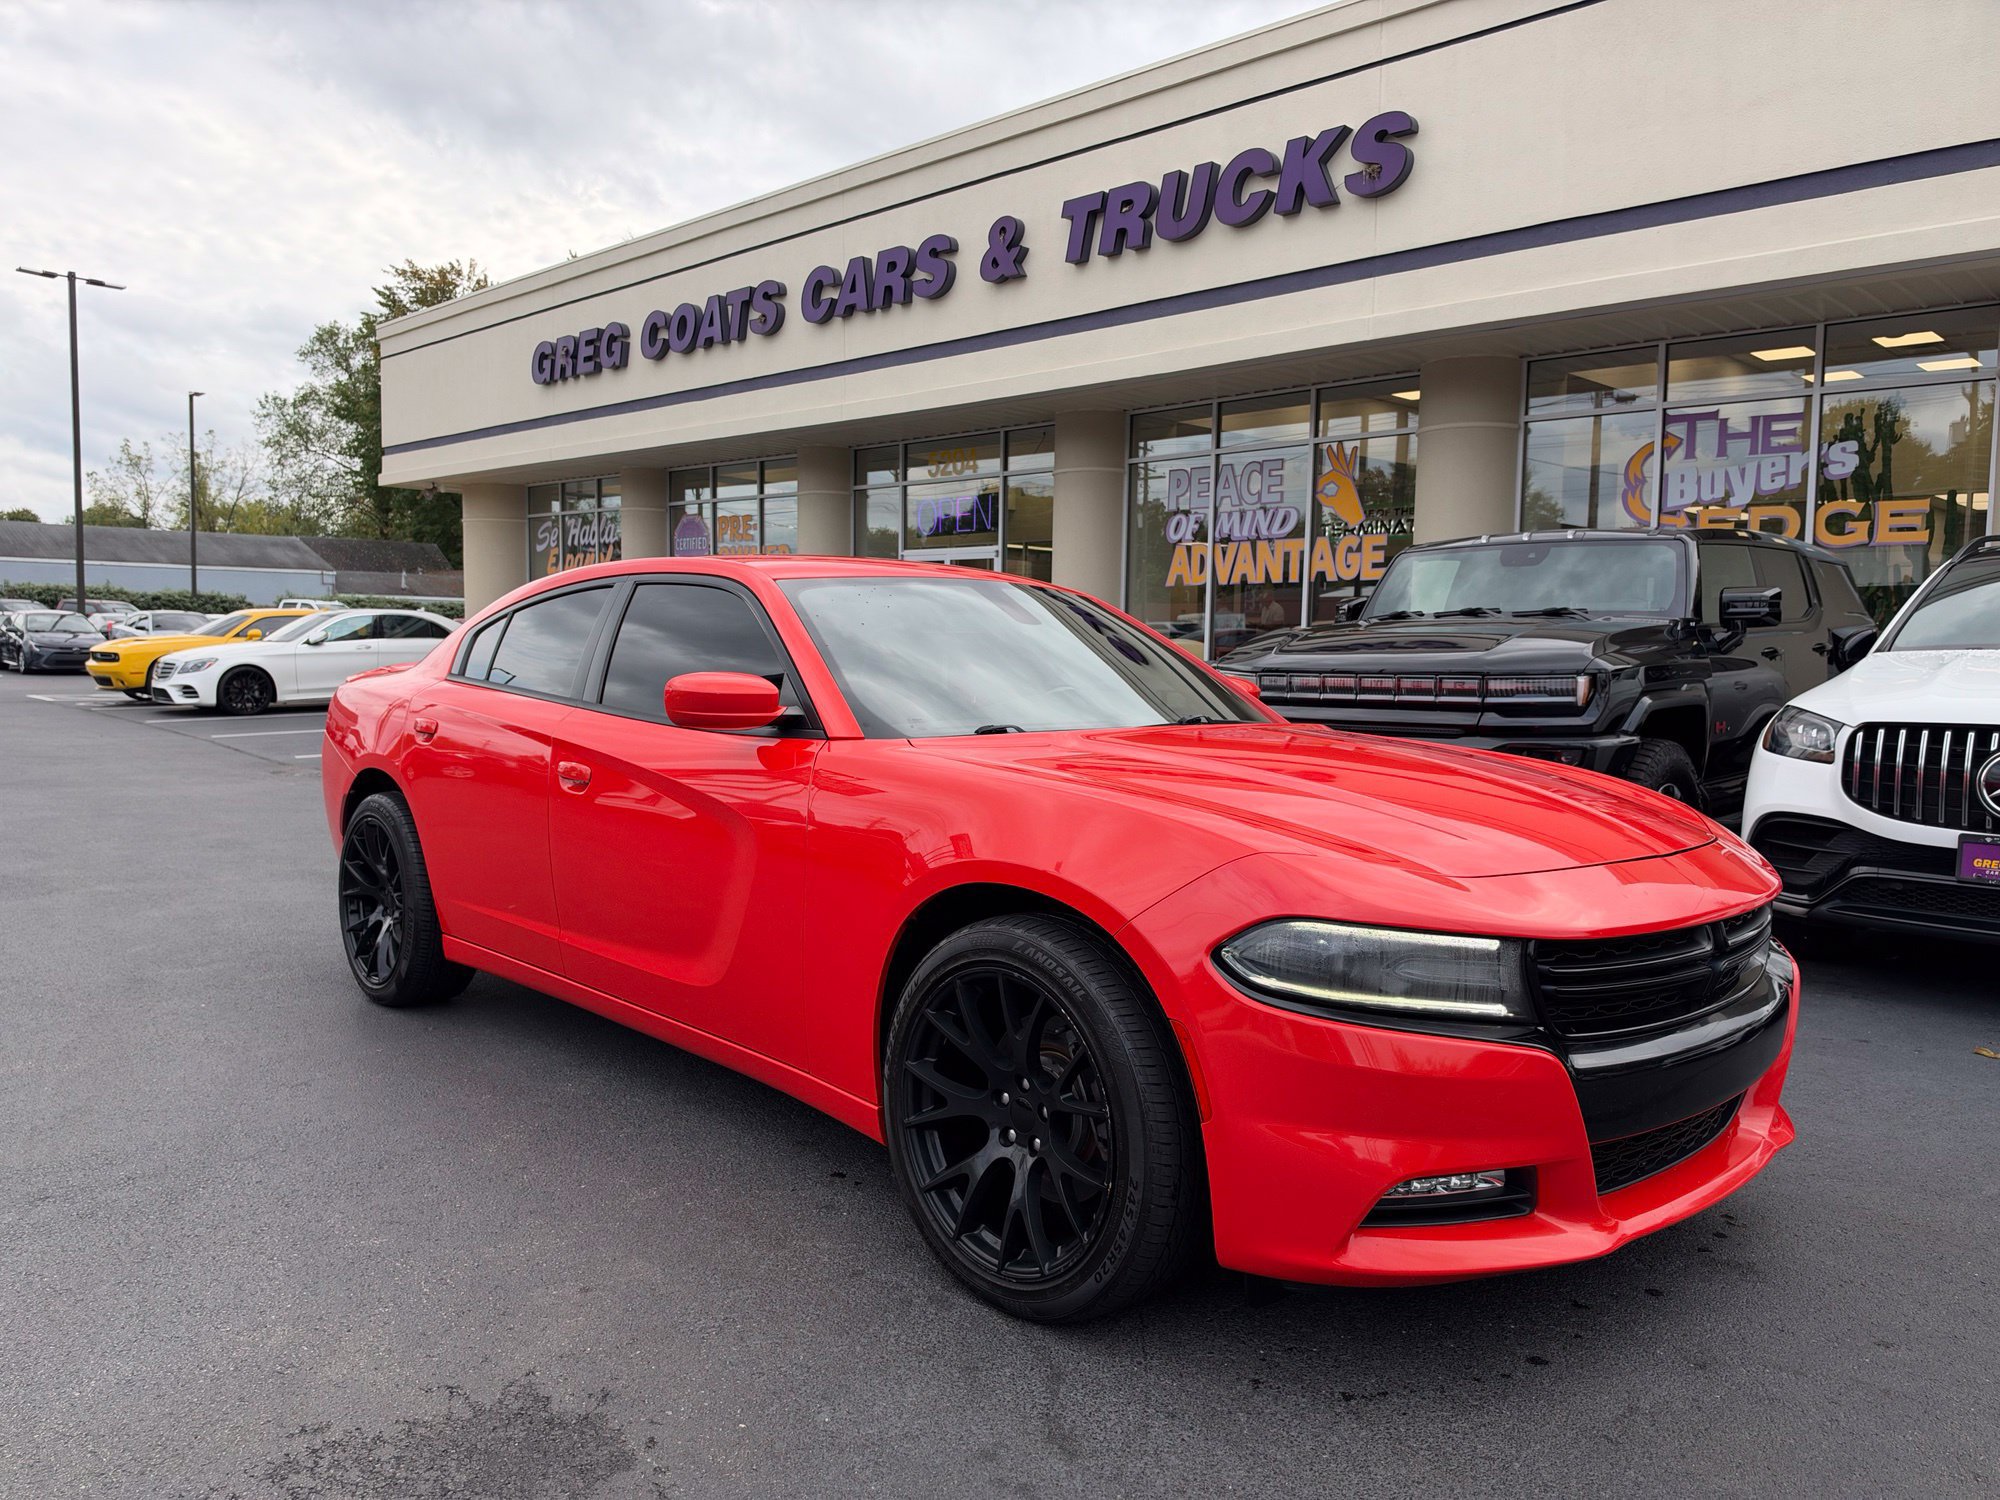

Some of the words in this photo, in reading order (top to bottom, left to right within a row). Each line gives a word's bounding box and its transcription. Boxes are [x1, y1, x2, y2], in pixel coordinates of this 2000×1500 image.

[532, 321, 630, 386] GREG
[640, 279, 787, 361] COATS
[801, 233, 959, 325] CARS
[980, 215, 1030, 284] &
[1061, 110, 1419, 265] TRUCKS
[1664, 408, 1804, 461] THE
[928, 447, 978, 478] 5204
[1168, 458, 1284, 511] PEACE
[536, 521, 559, 552] Se
[565, 515, 618, 547] Habla
[917, 494, 992, 536] OPEN
[1166, 511, 1205, 544] OF
[1215, 507, 1300, 542] MIND
[676, 537, 707, 551] CERTIFIED
[1165, 533, 1388, 587] ADVANTAGE
[1715, 719, 1727, 737] H
[1973, 858, 2000, 869] GRE
[1011, 940, 1089, 1002] LANDSAIL
[1094, 1176, 1139, 1283] 245/45R20
